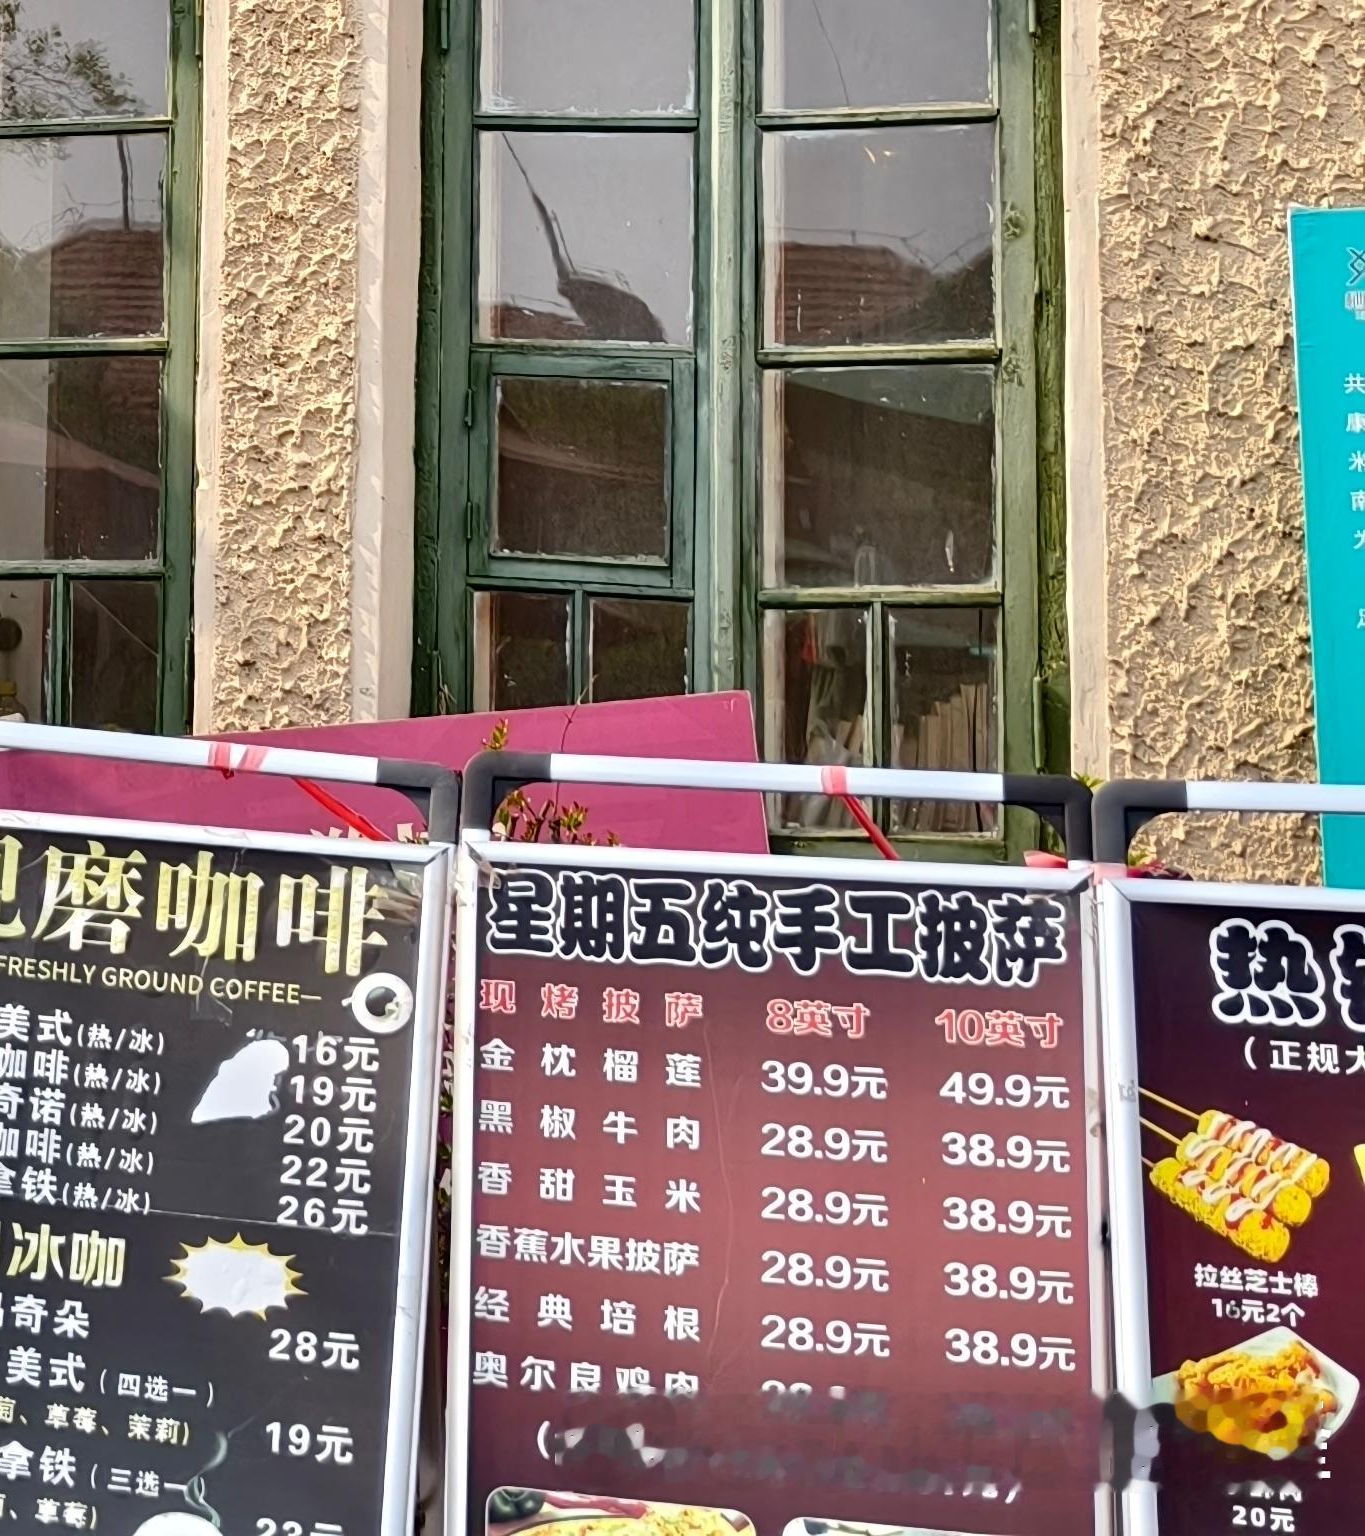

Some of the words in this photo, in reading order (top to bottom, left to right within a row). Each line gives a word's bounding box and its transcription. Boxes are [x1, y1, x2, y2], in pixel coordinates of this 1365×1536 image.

[484, 868, 1067, 989] 星期五纯手工披萨
[101, 965, 204, 996] GROUND
[479, 979, 704, 1030] 现烤披萨
[765, 999, 871, 1041] 8英寸
[934, 1007, 1064, 1051] 10英寸
[292, 1033, 380, 1074] 16元
[479, 1037, 703, 1092] 金枕榴莲
[760, 1060, 888, 1104] 39.9元
[938, 1072, 1071, 1113] 49.9元
[289, 1073, 377, 1114] 19元
[282, 1114, 375, 1154] 20元
[478, 1099, 702, 1152] 黑椒牛肉
[760, 1122, 888, 1167] 28.9元
[941, 1132, 1071, 1175] 38.9元
[279, 1153, 371, 1195] 22元
[276, 1195, 370, 1236] 26元
[478, 1160, 701, 1215] 香甜玉米
[760, 1186, 889, 1229] 28.9元
[942, 1196, 1072, 1240] 38.9元
[475, 1224, 701, 1278] 香蕉水果披萨
[760, 1251, 890, 1295] 28.9元
[943, 1262, 1075, 1307] 38.9元
[1194, 1263, 1319, 1298] 拉丝芝士棒
[268, 1328, 361, 1371] 28元
[473, 1286, 702, 1344] 经典培根
[760, 1315, 891, 1360] 28.9元
[944, 1328, 1076, 1373] 38.9元
[265, 1421, 355, 1464] 19元
[1232, 1504, 1296, 1533] 20元
